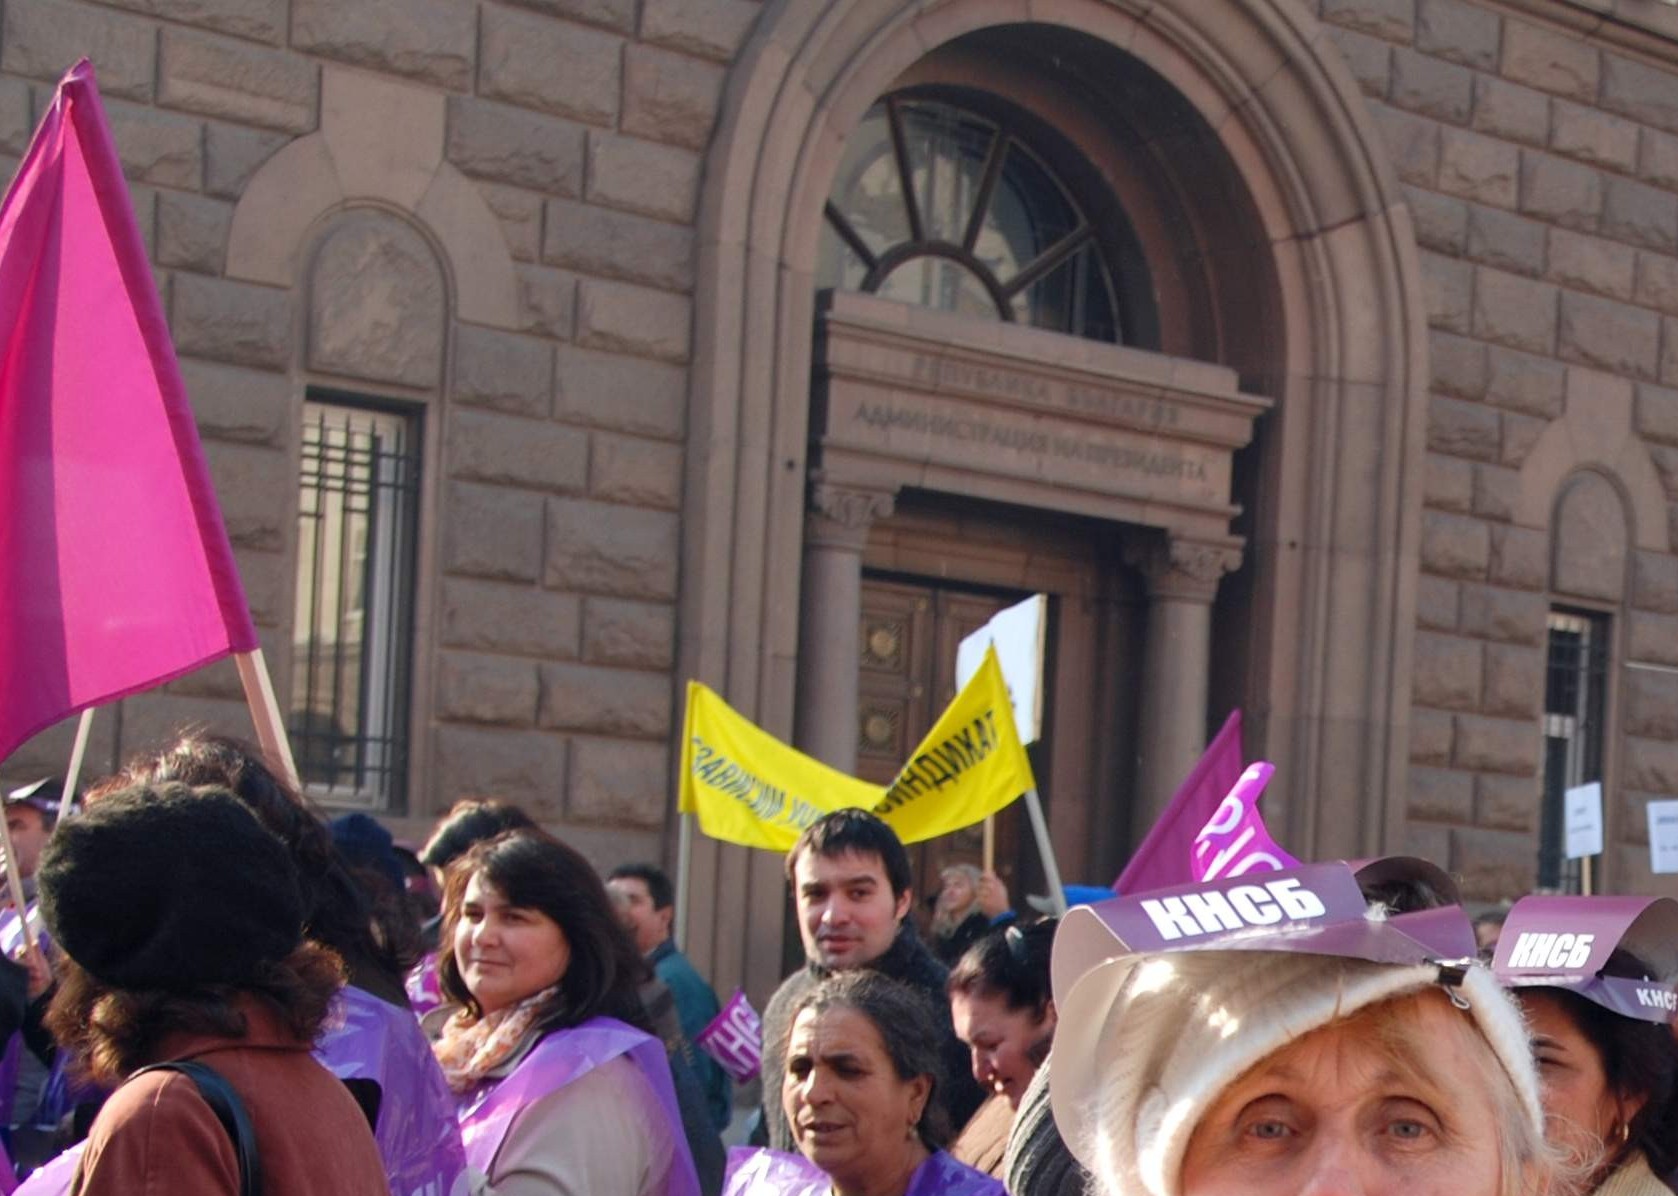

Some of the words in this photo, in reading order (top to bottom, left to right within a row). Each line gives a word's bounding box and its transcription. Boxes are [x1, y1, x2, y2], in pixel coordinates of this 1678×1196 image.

[854, 401, 1050, 455] АДМИНИСТРАЦИЯ
[1086, 441, 1207, 482] ПРЕЗИДЕНТА
[1140, 878, 1326, 941] КНСБ
[1507, 932, 1595, 969] КНСБ
